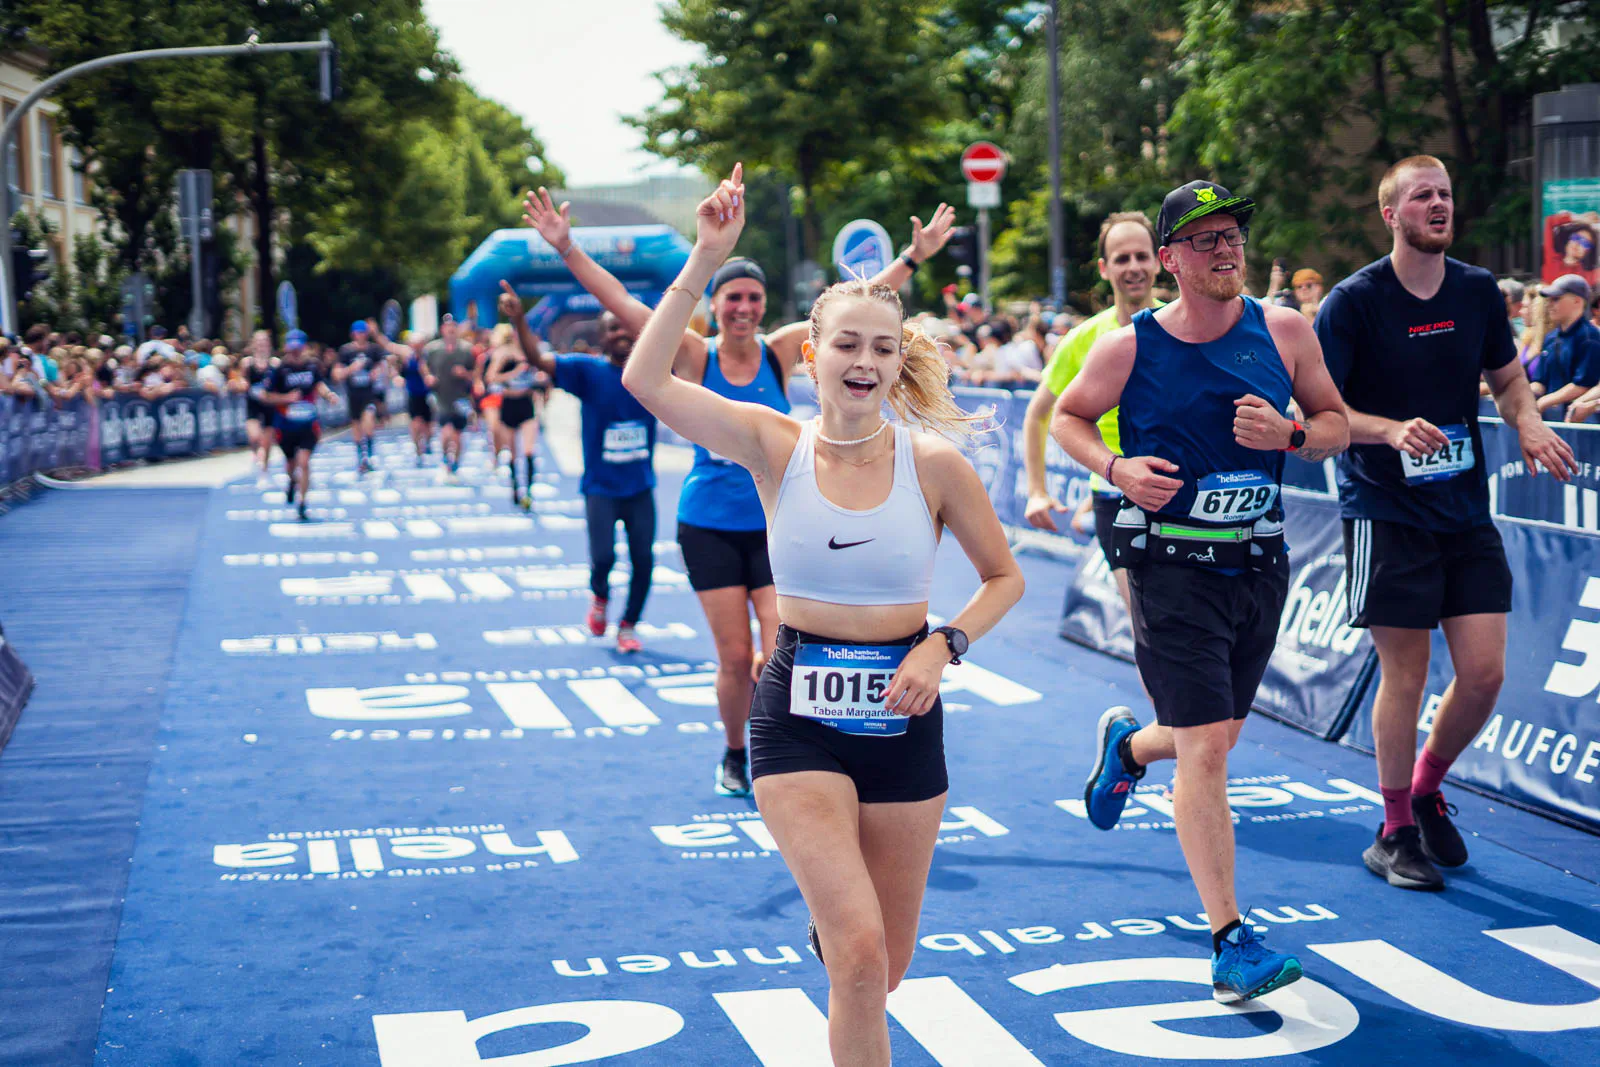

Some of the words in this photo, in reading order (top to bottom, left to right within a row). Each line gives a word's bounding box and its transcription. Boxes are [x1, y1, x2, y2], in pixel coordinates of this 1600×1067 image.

[1408, 324, 1432, 334] NIKE
[1433, 320, 1455, 330] PRO
[1203, 486, 1271, 514] 6729
[1278, 562, 1364, 656] hella
[828, 647, 854, 660] hella
[804, 671, 899, 704] 1015
[813, 706, 843, 717] Tabea
[1474, 714, 1600, 784] AUFGE
[268, 823, 505, 840] mineralbrunnen
[213, 830, 580, 874] hella
[327, 870, 376, 881] AUF
[388, 866, 476, 877] GRUND
[486, 861, 539, 873] VON
[552, 903, 1340, 978] mineralbnnen
